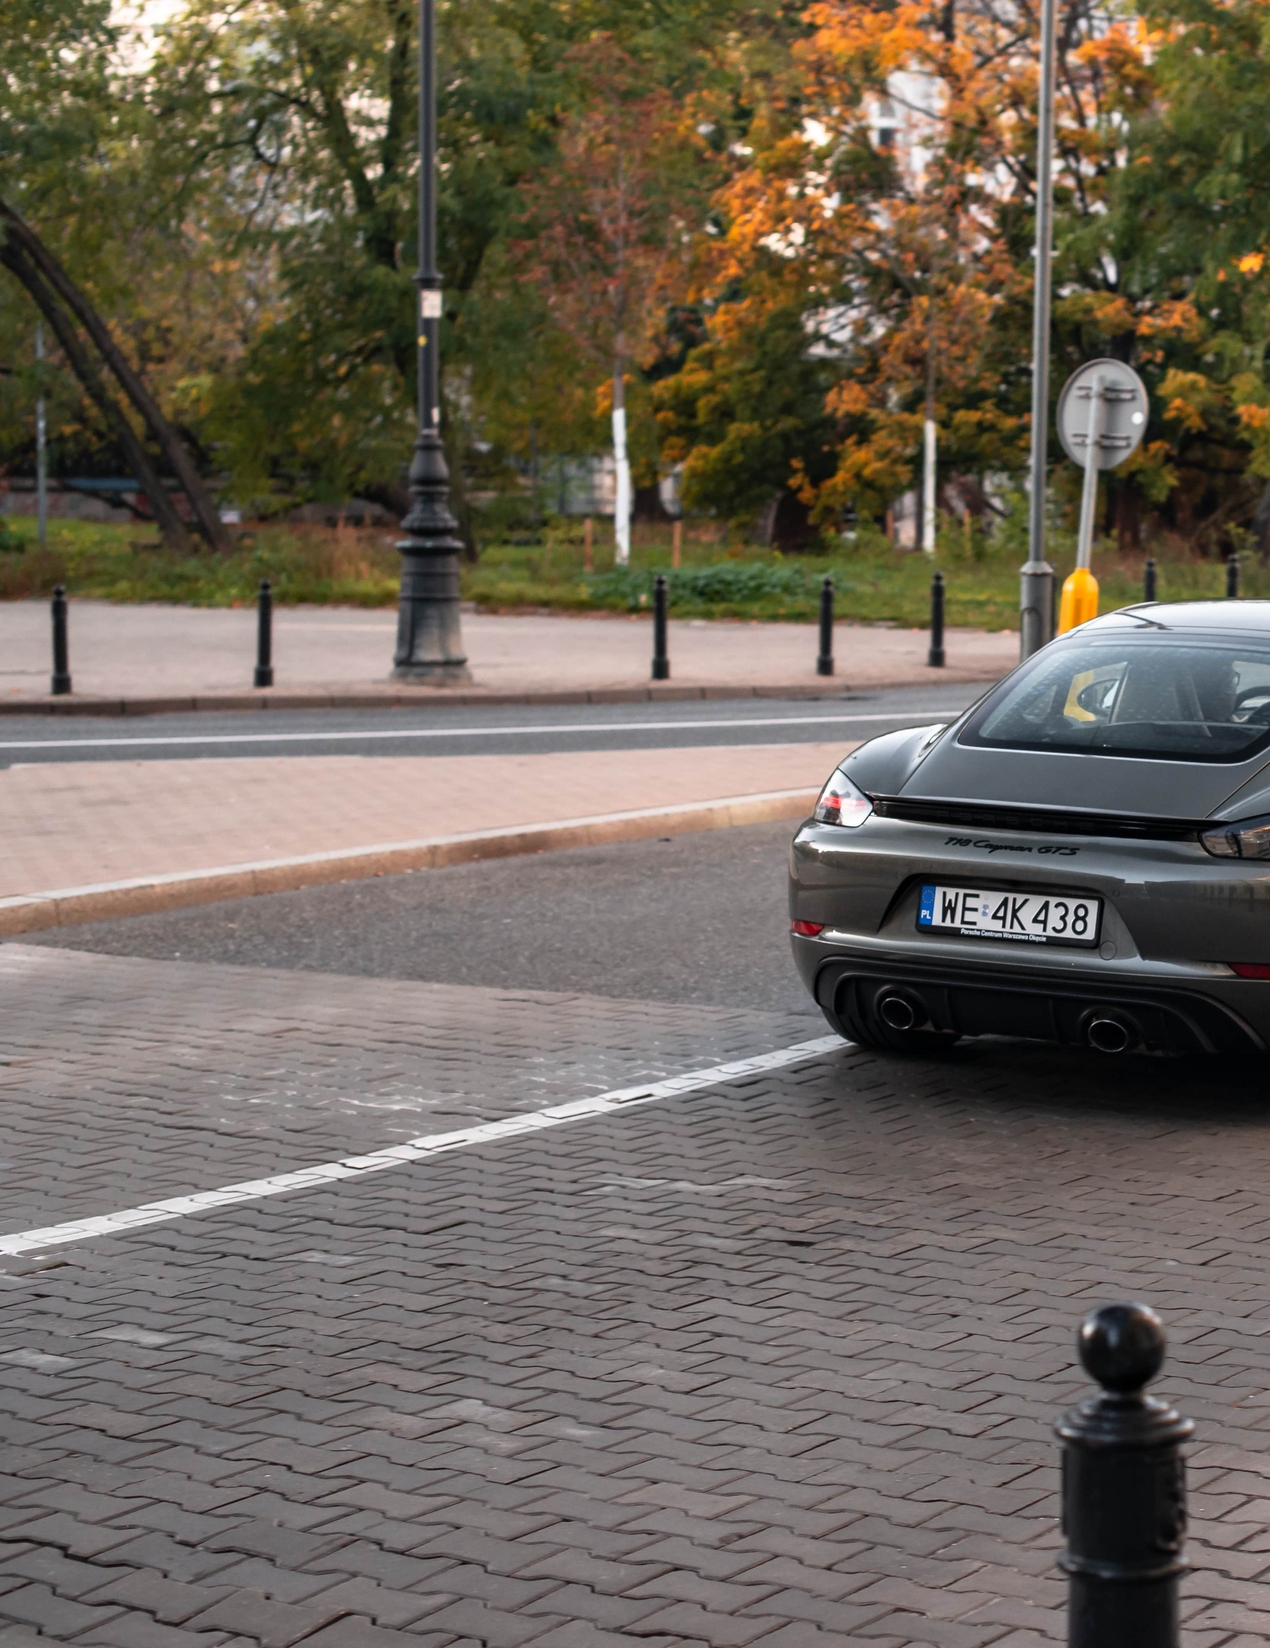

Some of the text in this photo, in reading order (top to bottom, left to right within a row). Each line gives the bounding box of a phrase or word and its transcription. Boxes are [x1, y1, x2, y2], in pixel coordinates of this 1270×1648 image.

[944, 837, 1080, 856] 718 Cayman GTS
[921, 909, 931, 920] PL
[941, 890, 1089, 936] WE 4K438
[960, 928, 981, 937] Porsche
[981, 930, 1003, 938] Centrum
[1003, 932, 1028, 940] Warszawa
